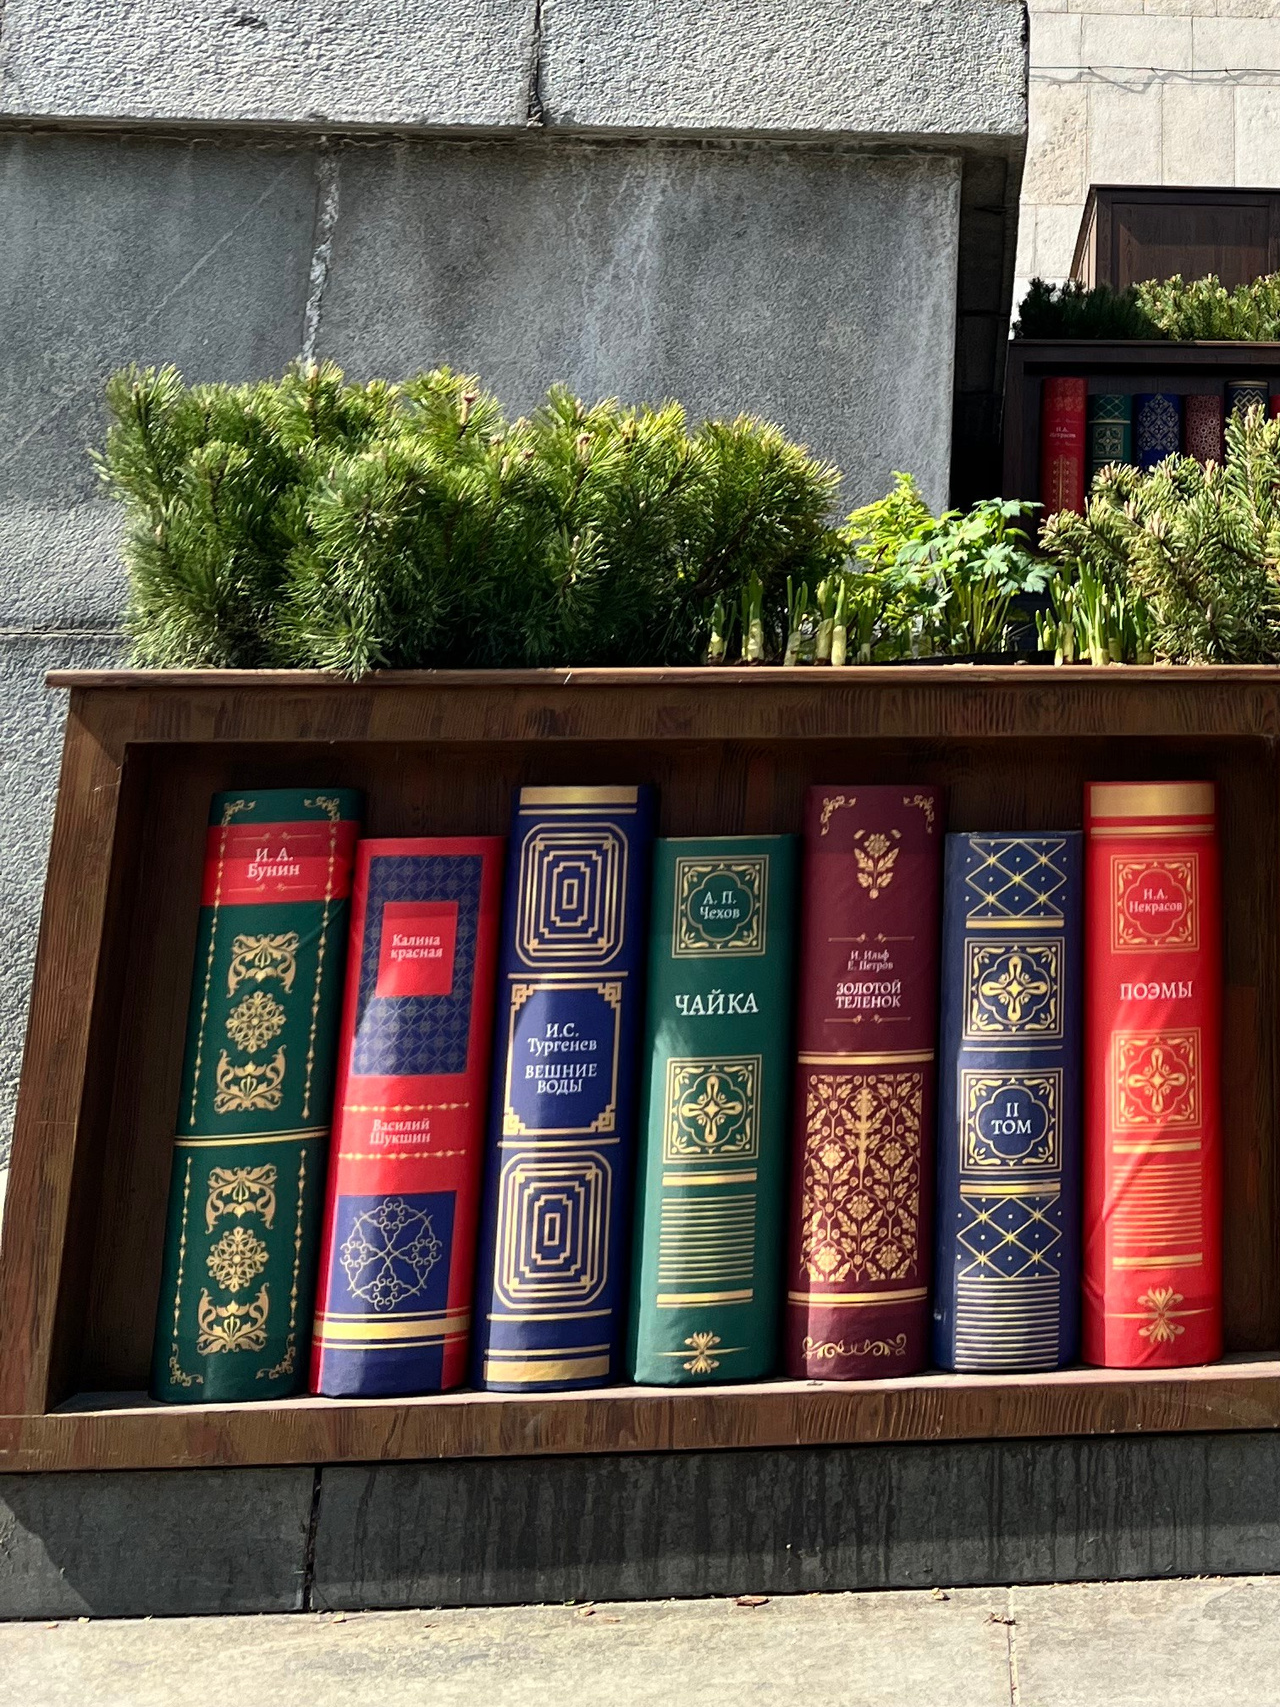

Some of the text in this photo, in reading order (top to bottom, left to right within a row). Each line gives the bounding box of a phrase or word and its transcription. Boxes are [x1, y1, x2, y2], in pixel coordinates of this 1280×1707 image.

[247, 862, 300, 878] Бунин
[1143, 889, 1169, 900] Н.А.
[699, 906, 740, 920] Чехов
[1129, 900, 1182, 915] Некрасов
[392, 934, 440, 945] Калина
[390, 945, 443, 960] красная
[865, 950, 889, 962] Ильф
[859, 960, 894, 972] Петров
[836, 980, 901, 995] ЗОЛОТОЙ
[1119, 982, 1193, 1000] ПОЭМЫ
[674, 990, 760, 1015] ЧАЙКА
[545, 1023, 579, 1037] И.С.
[527, 1036, 597, 1055] Тургенев
[525, 1063, 597, 1079] ВЕШНИЕ
[537, 1078, 582, 1095] ВОДЫ
[372, 1118, 430, 1132] Василий
[991, 1118, 1032, 1135] ТОМ
[369, 1132, 430, 1146] Шукшин
